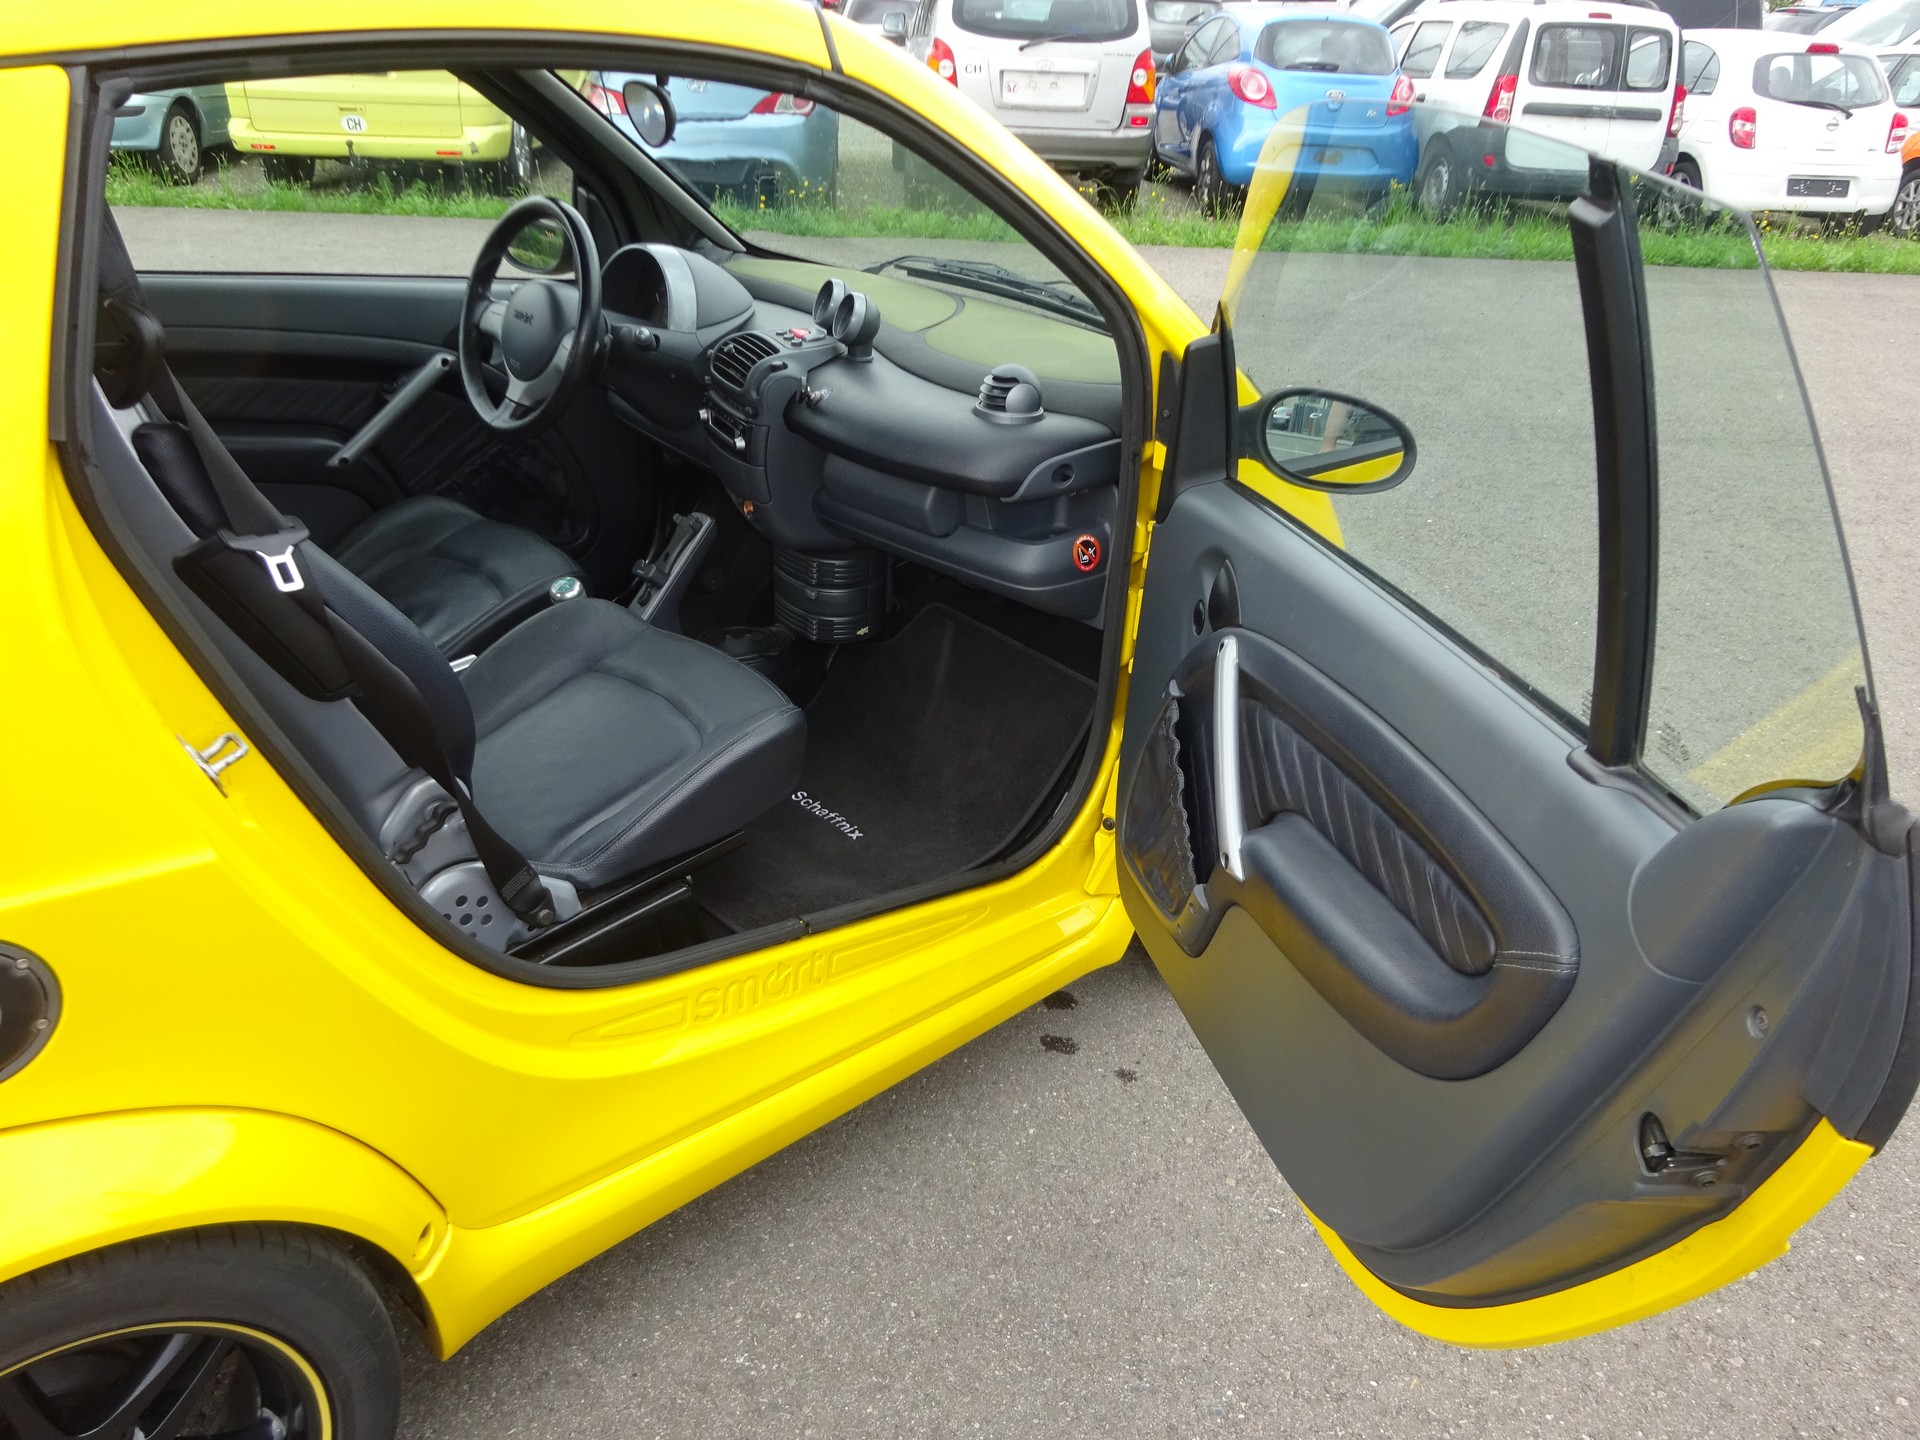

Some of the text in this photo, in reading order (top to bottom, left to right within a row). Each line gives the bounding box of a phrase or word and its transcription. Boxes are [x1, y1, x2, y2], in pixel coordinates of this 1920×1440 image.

[965, 64, 982, 74] CH
[346, 117, 362, 131] CH
[791, 791, 864, 840] Schaffnix
[693, 950, 825, 1025] smart
